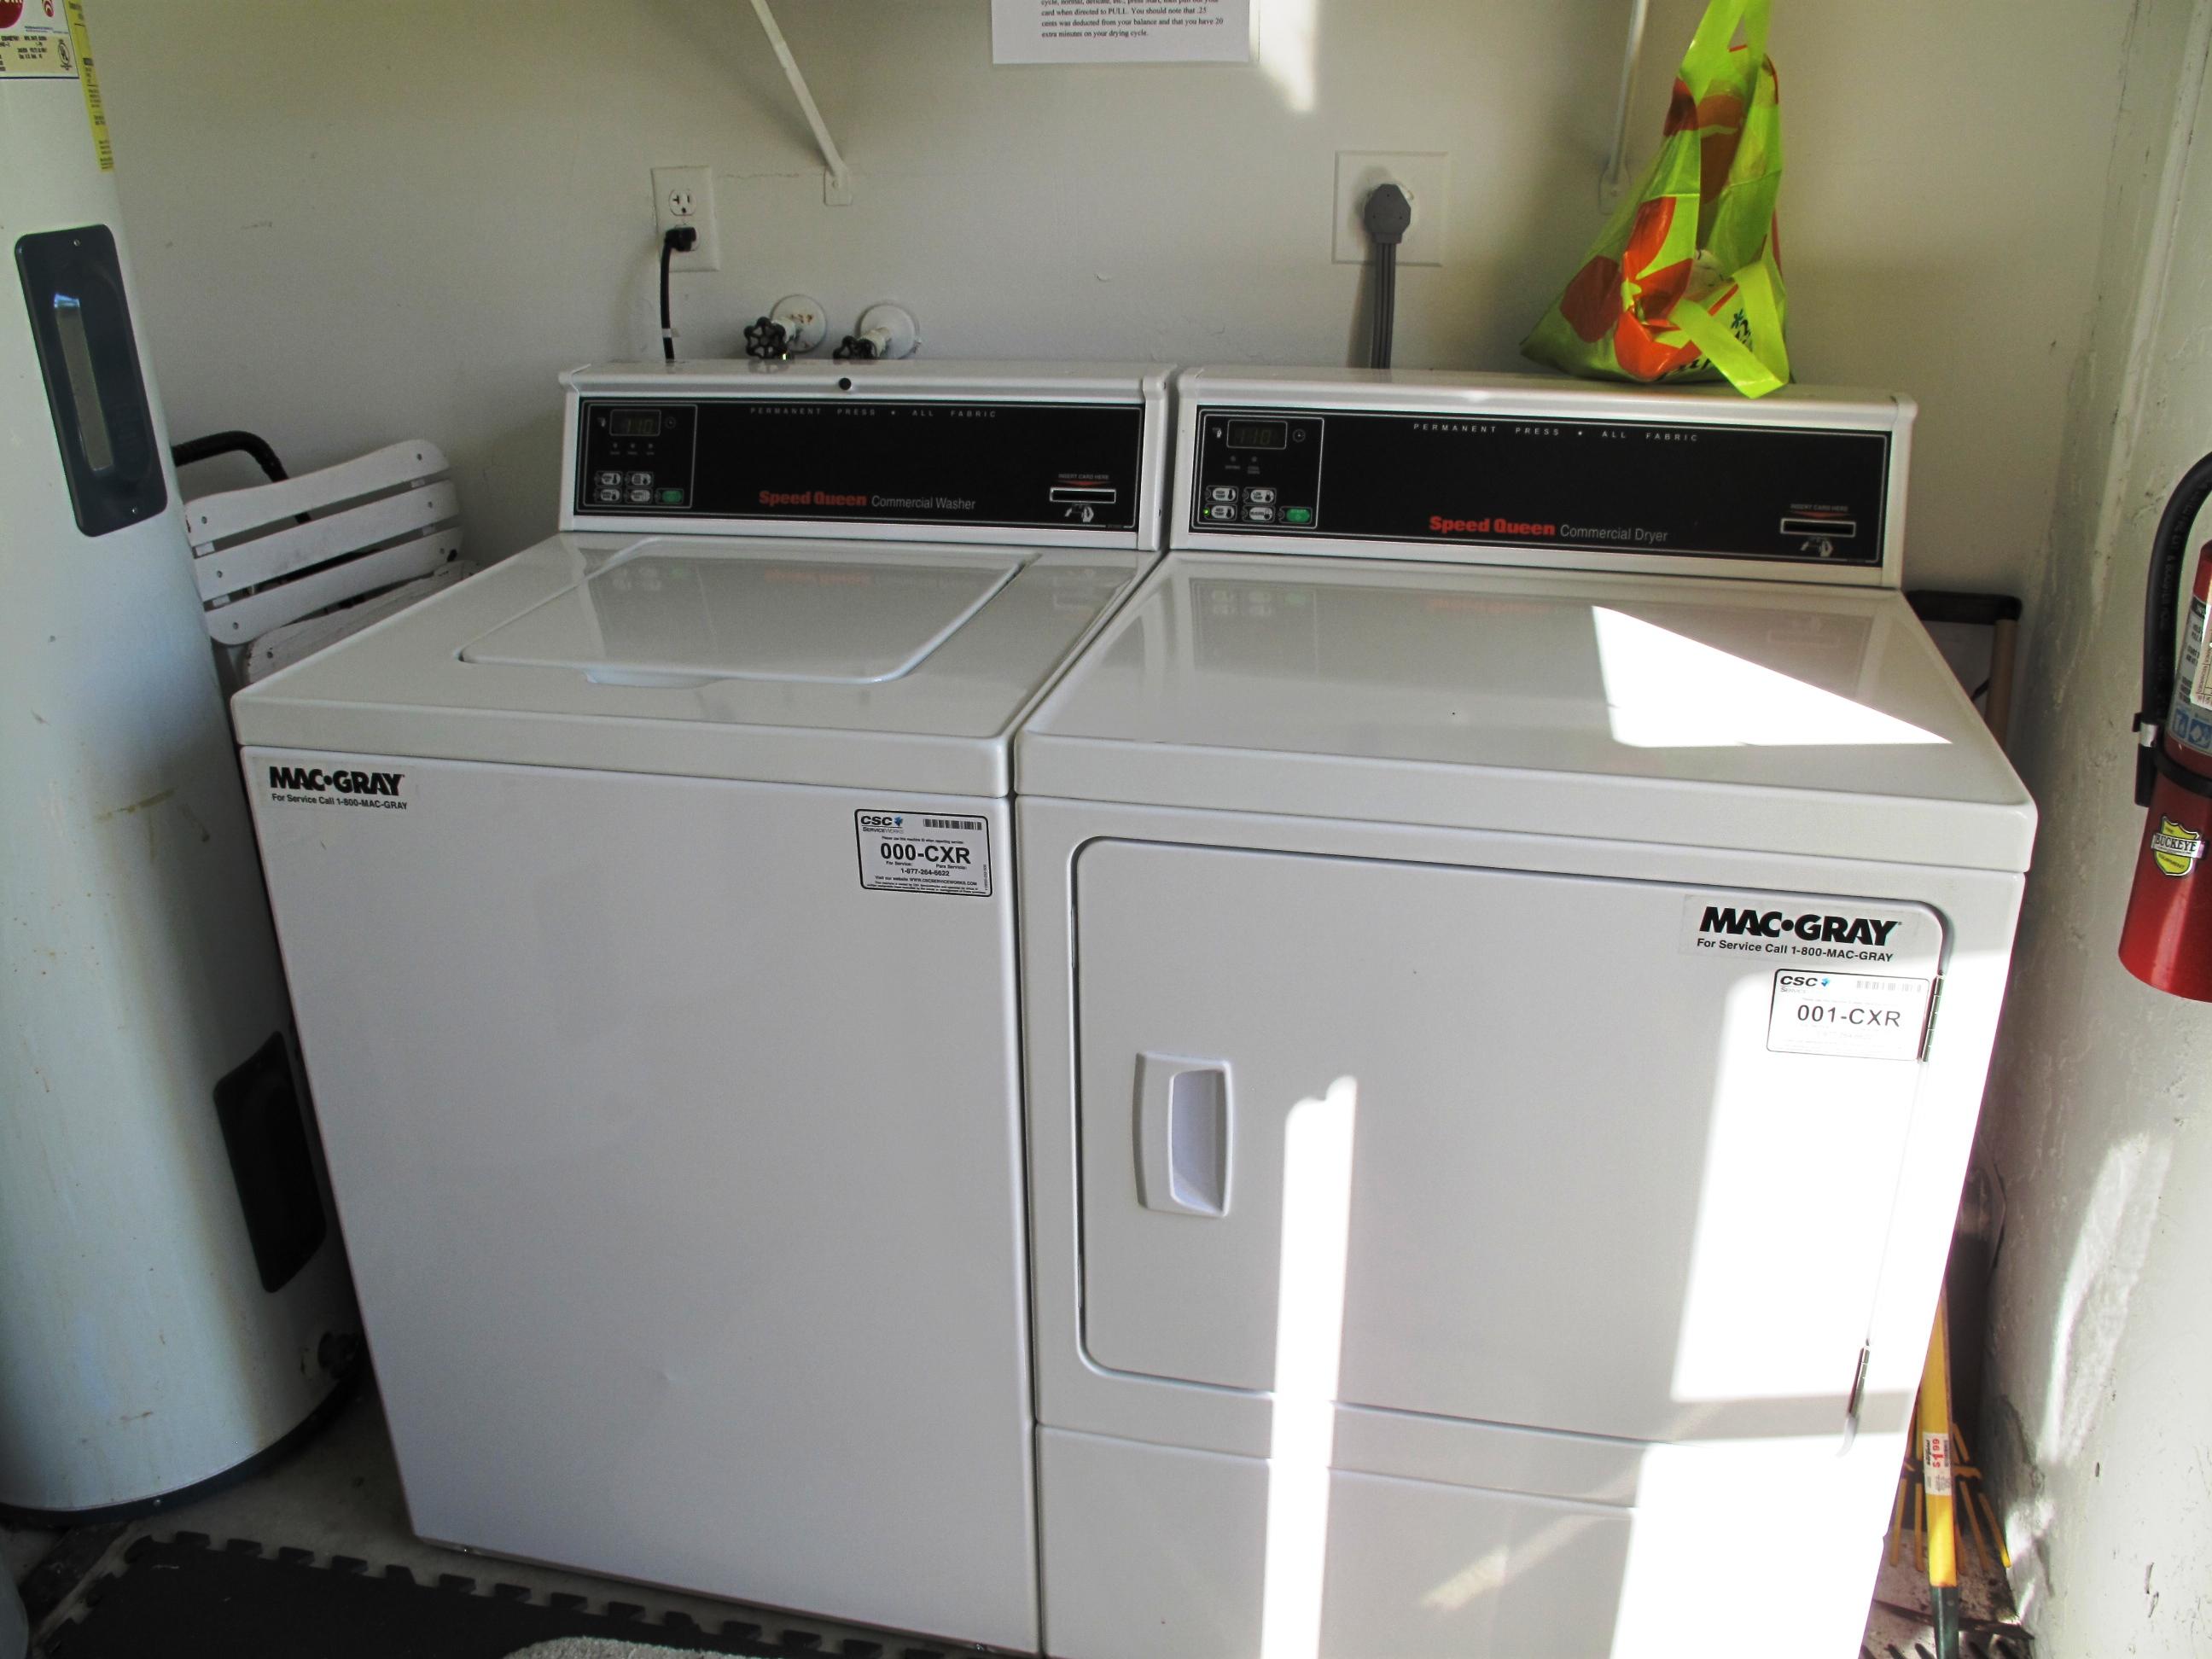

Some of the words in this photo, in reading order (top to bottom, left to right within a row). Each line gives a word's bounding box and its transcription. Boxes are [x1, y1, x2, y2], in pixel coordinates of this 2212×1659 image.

[1130, 29, 1149, 38] cycle.
[750, 406, 822, 415] PERMANENT
[837, 408, 876, 416] PRESS
[950, 410, 998, 418] FABRIC
[1413, 422, 1497, 433] PERMANENT
[1516, 427, 1560, 437] PRESS
[1646, 432, 1697, 442] FABRIC
[759, 490, 811, 507] Speed
[814, 492, 867, 506] Queen
[871, 495, 934, 509] Commercial
[935, 498, 976, 510] Washer
[1429, 515, 1490, 534] Speed
[1493, 518, 1556, 536] Queen
[1560, 524, 1632, 541] Commercial
[1634, 527, 1668, 544] Dryer
[271, 793, 284, 802] For
[286, 795, 317, 804] Service
[318, 796, 335, 806] Call
[336, 798, 408, 810] 1-800-MAC-GRAY
[860, 815, 893, 826] CSC
[2155, 835, 2197, 852] BUCKEYE
[880, 842, 971, 864] 000-CXR
[900, 868, 950, 876] 1-877-264-6622
[1697, 938, 1716, 948] For
[1719, 940, 1762, 952] Service
[1765, 943, 1787, 954] Call
[1791, 946, 1894, 963] 1-800-MAC-GRAY
[1779, 975, 1819, 987] CSC
[1797, 1004, 1901, 1027] 001-CXR
